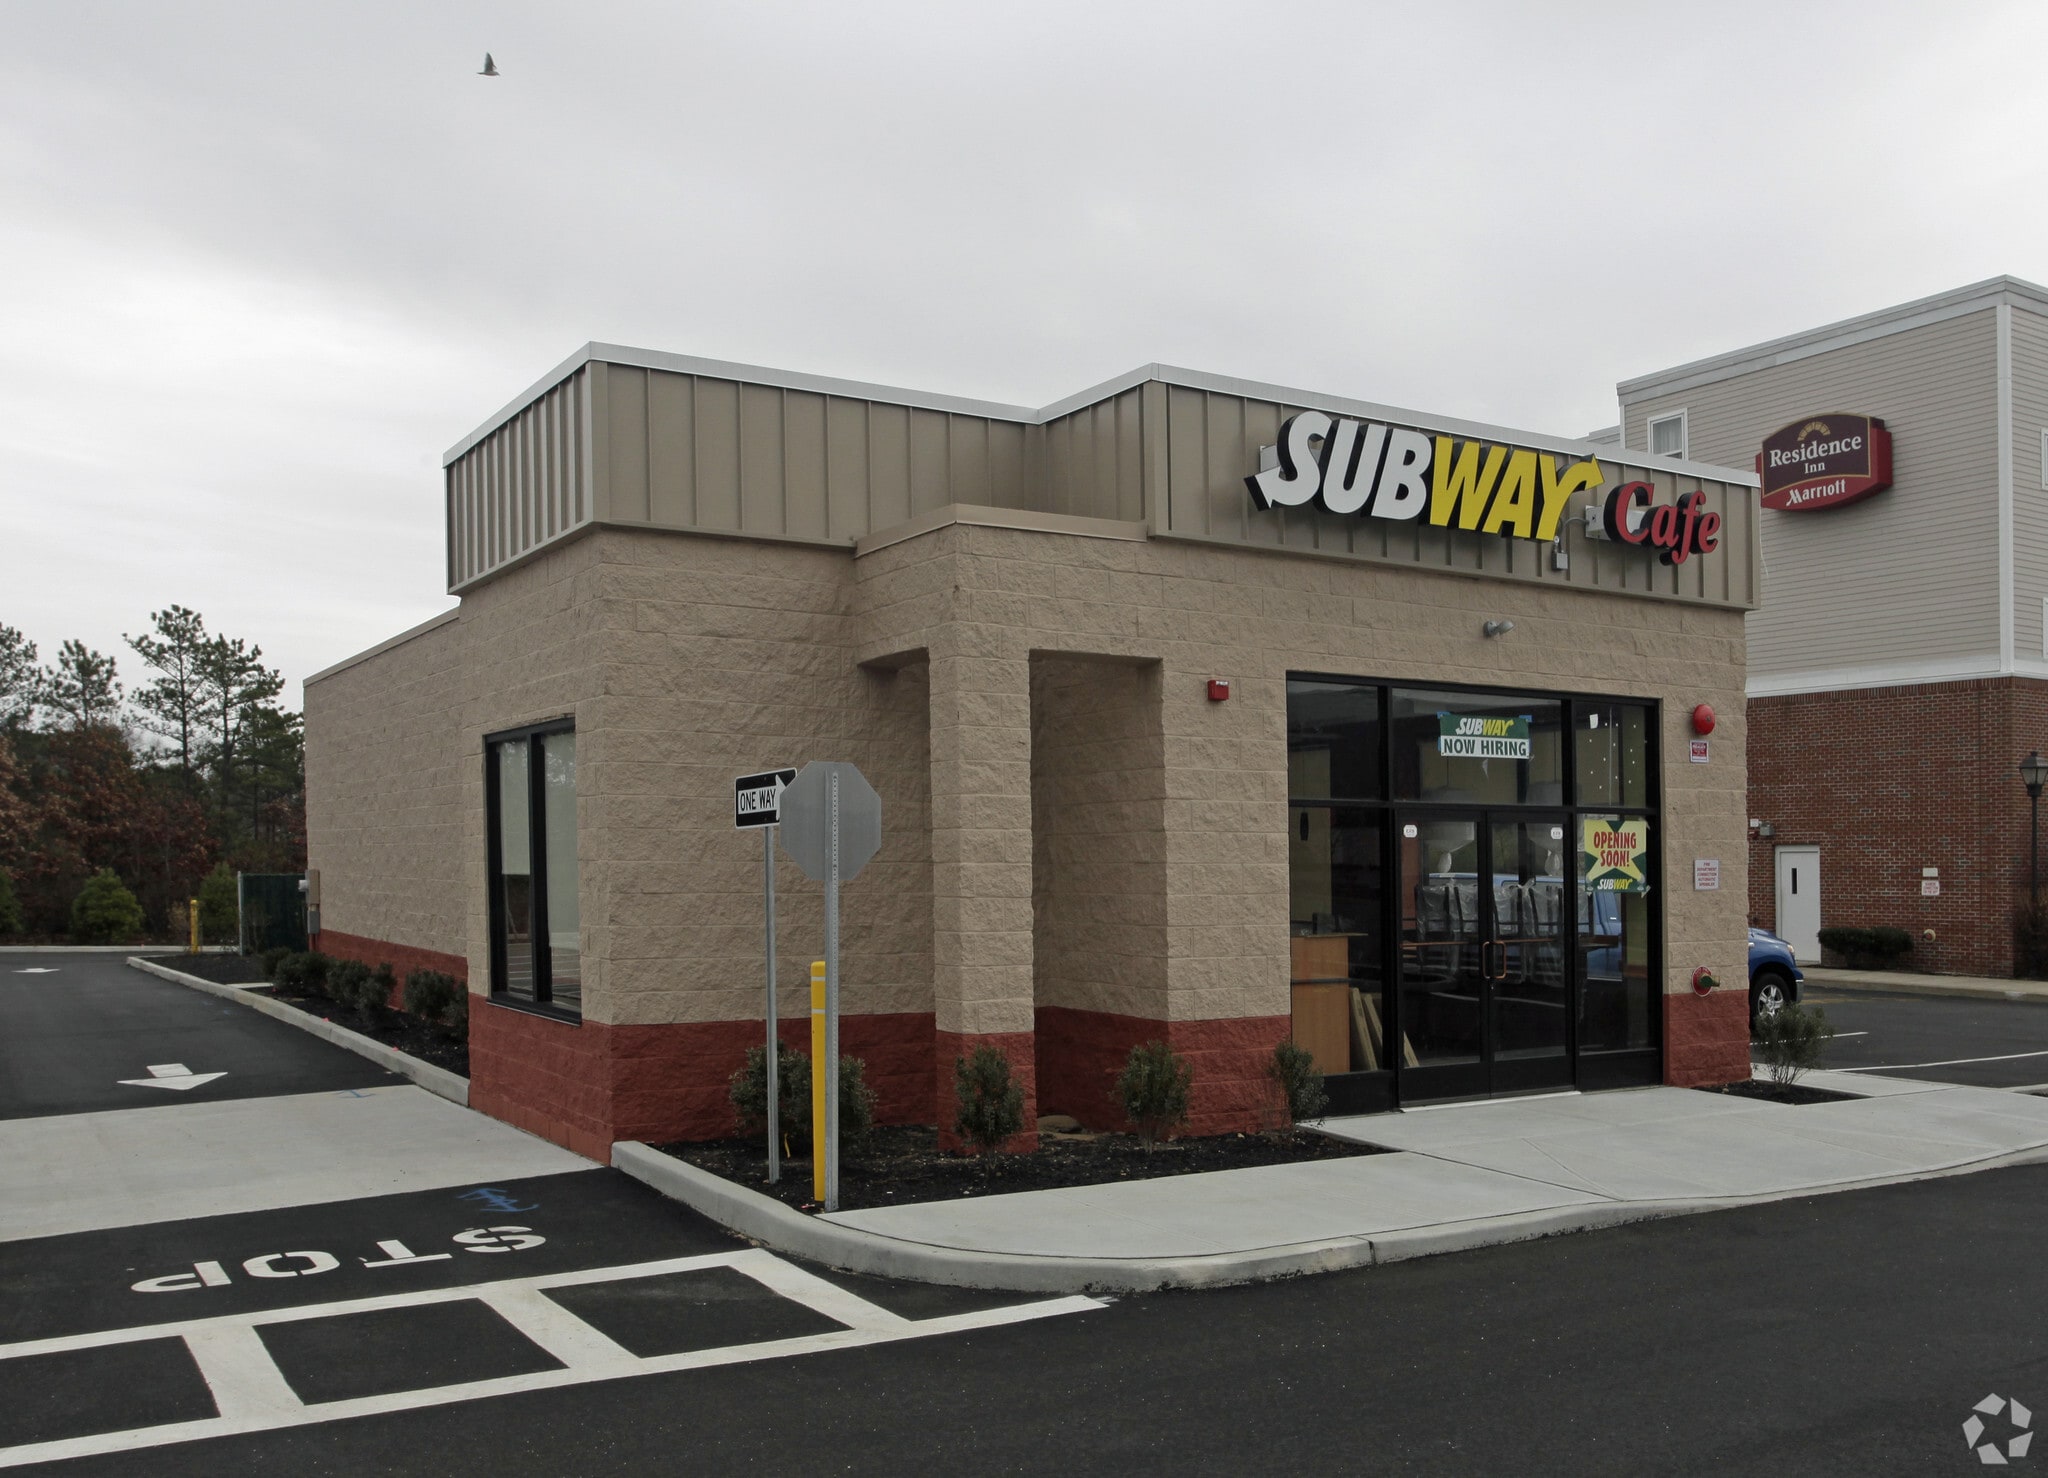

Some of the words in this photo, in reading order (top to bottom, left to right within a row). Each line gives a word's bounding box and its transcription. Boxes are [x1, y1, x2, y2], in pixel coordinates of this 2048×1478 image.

[1769, 435, 1862, 468] Residence
[1804, 462, 1826, 474] Inn
[1255, 410, 1606, 541] SUBWAY
[1611, 480, 1721, 565] Cafe
[1785, 479, 1847, 507] Marriott
[1455, 717, 1515, 737] SUBWAY
[1443, 738, 1476, 754] NOW
[1481, 740, 1527, 756] HIRING
[740, 790, 757, 811] ONE
[759, 788, 776, 809] WAY
[1593, 831, 1637, 849] OPENING
[1600, 850, 1630, 867] SOON!
[1597, 878, 1633, 890] SUBWAY
[130, 1225, 546, 1293] STOP
